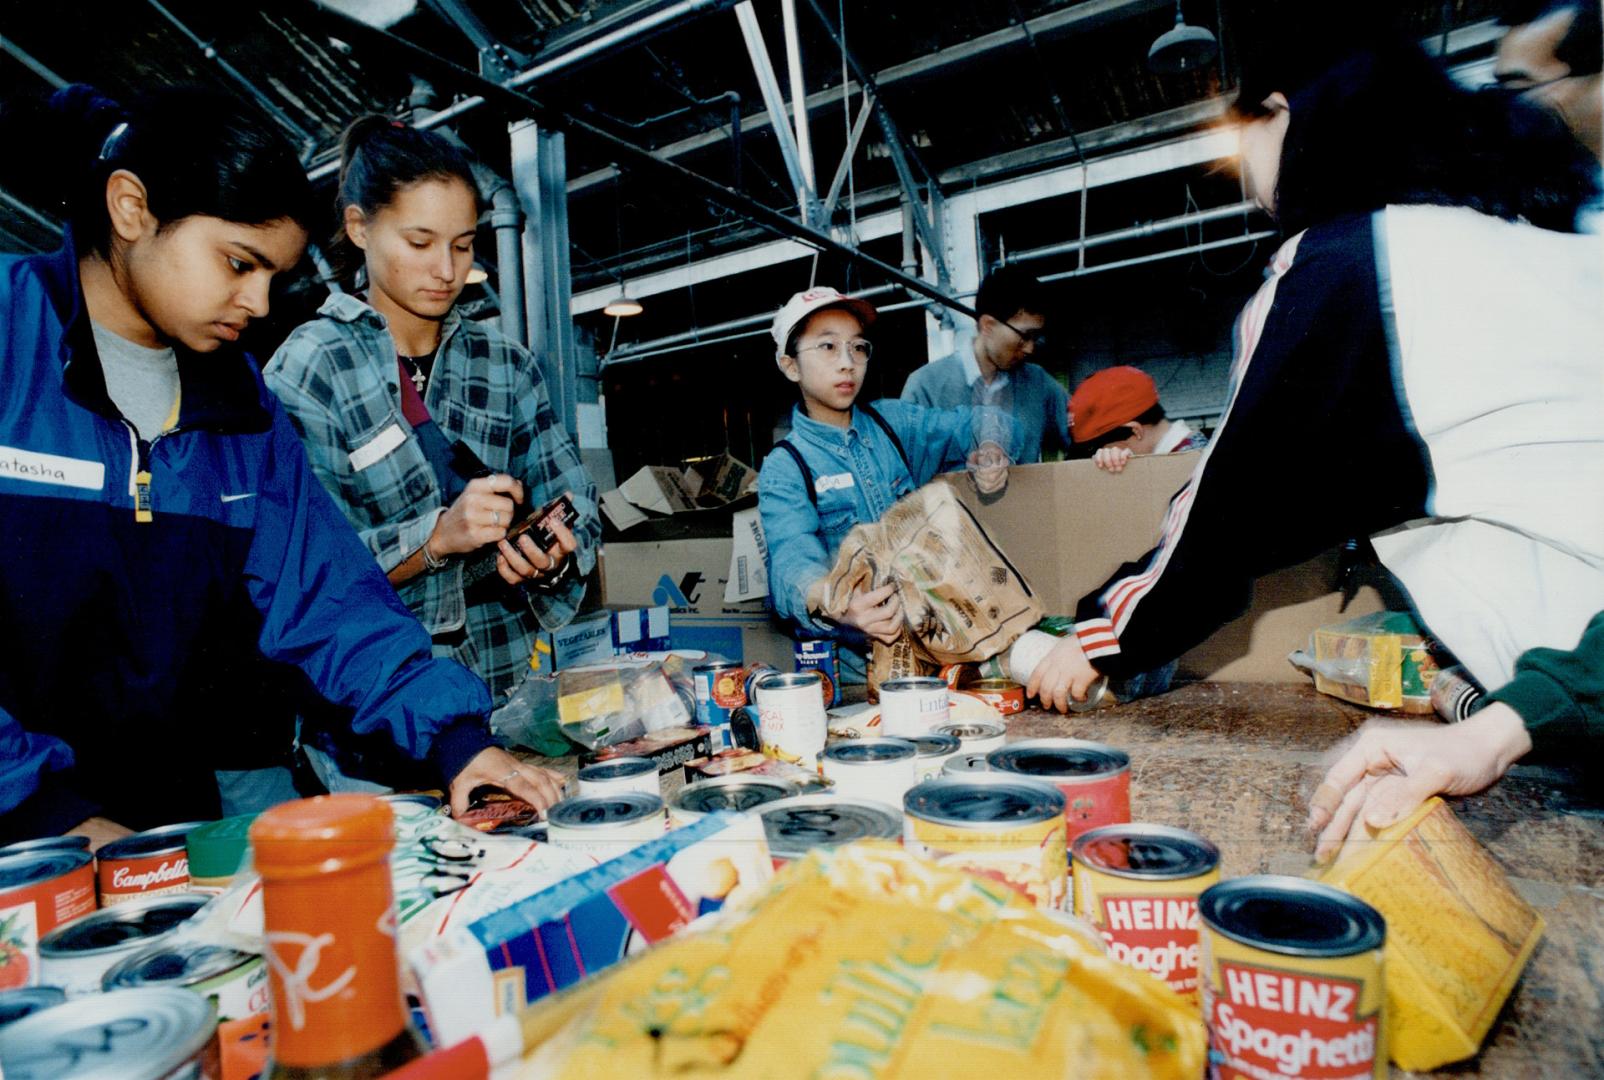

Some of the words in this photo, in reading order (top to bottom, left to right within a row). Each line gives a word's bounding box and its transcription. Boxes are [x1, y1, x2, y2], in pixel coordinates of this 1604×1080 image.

[557, 627, 607, 648] VEGETABLES
[1226, 968, 1357, 1024] HEINZ
[1215, 1002, 1378, 1076] Spaghetti
